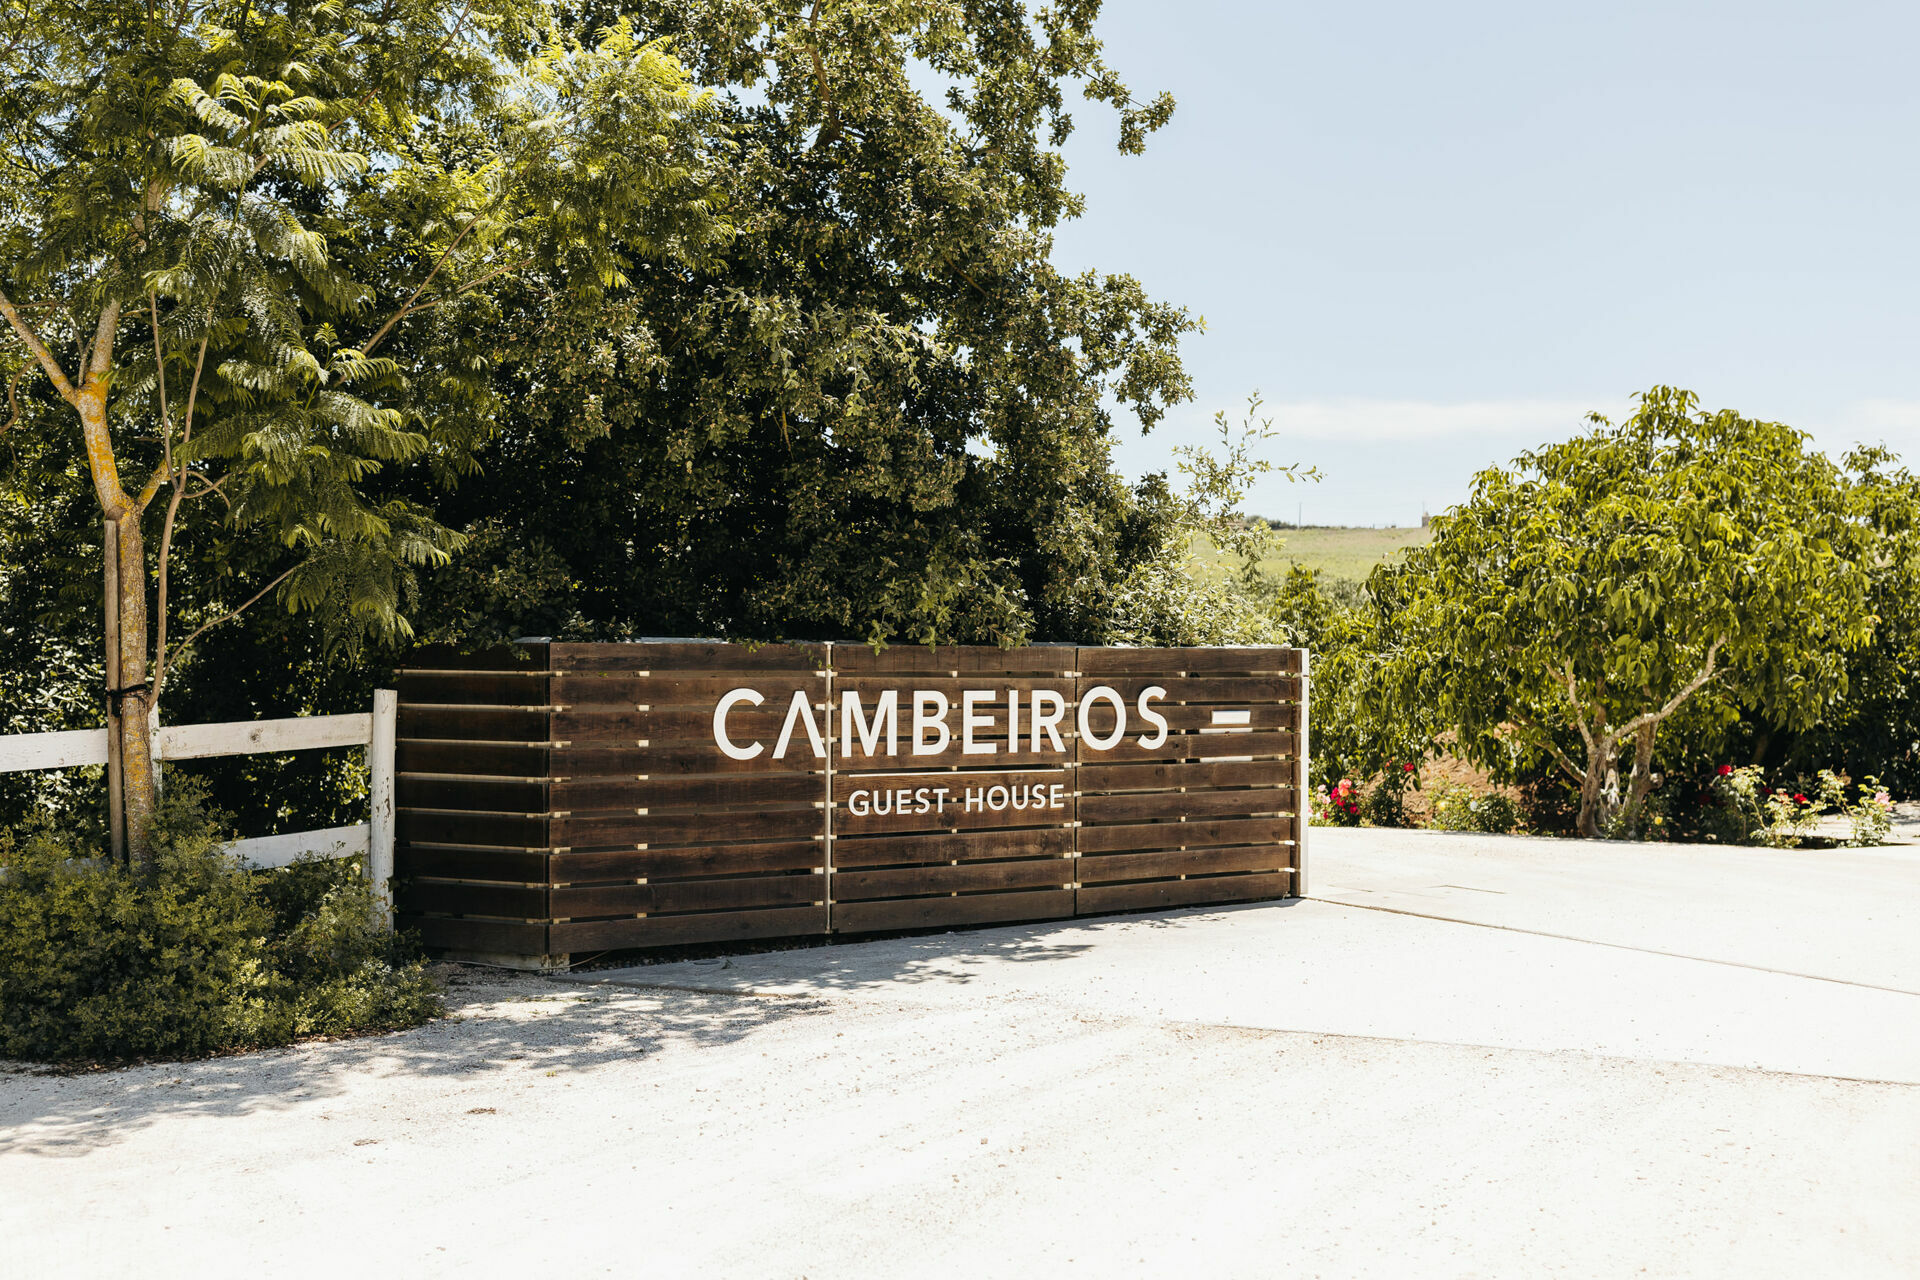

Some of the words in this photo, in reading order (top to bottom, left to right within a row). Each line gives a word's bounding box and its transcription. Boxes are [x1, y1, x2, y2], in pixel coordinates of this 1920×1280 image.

[713, 686, 1168, 760] CAMBEIROS
[848, 788, 950, 816] GUEST
[965, 784, 1065, 812] HOUSE
